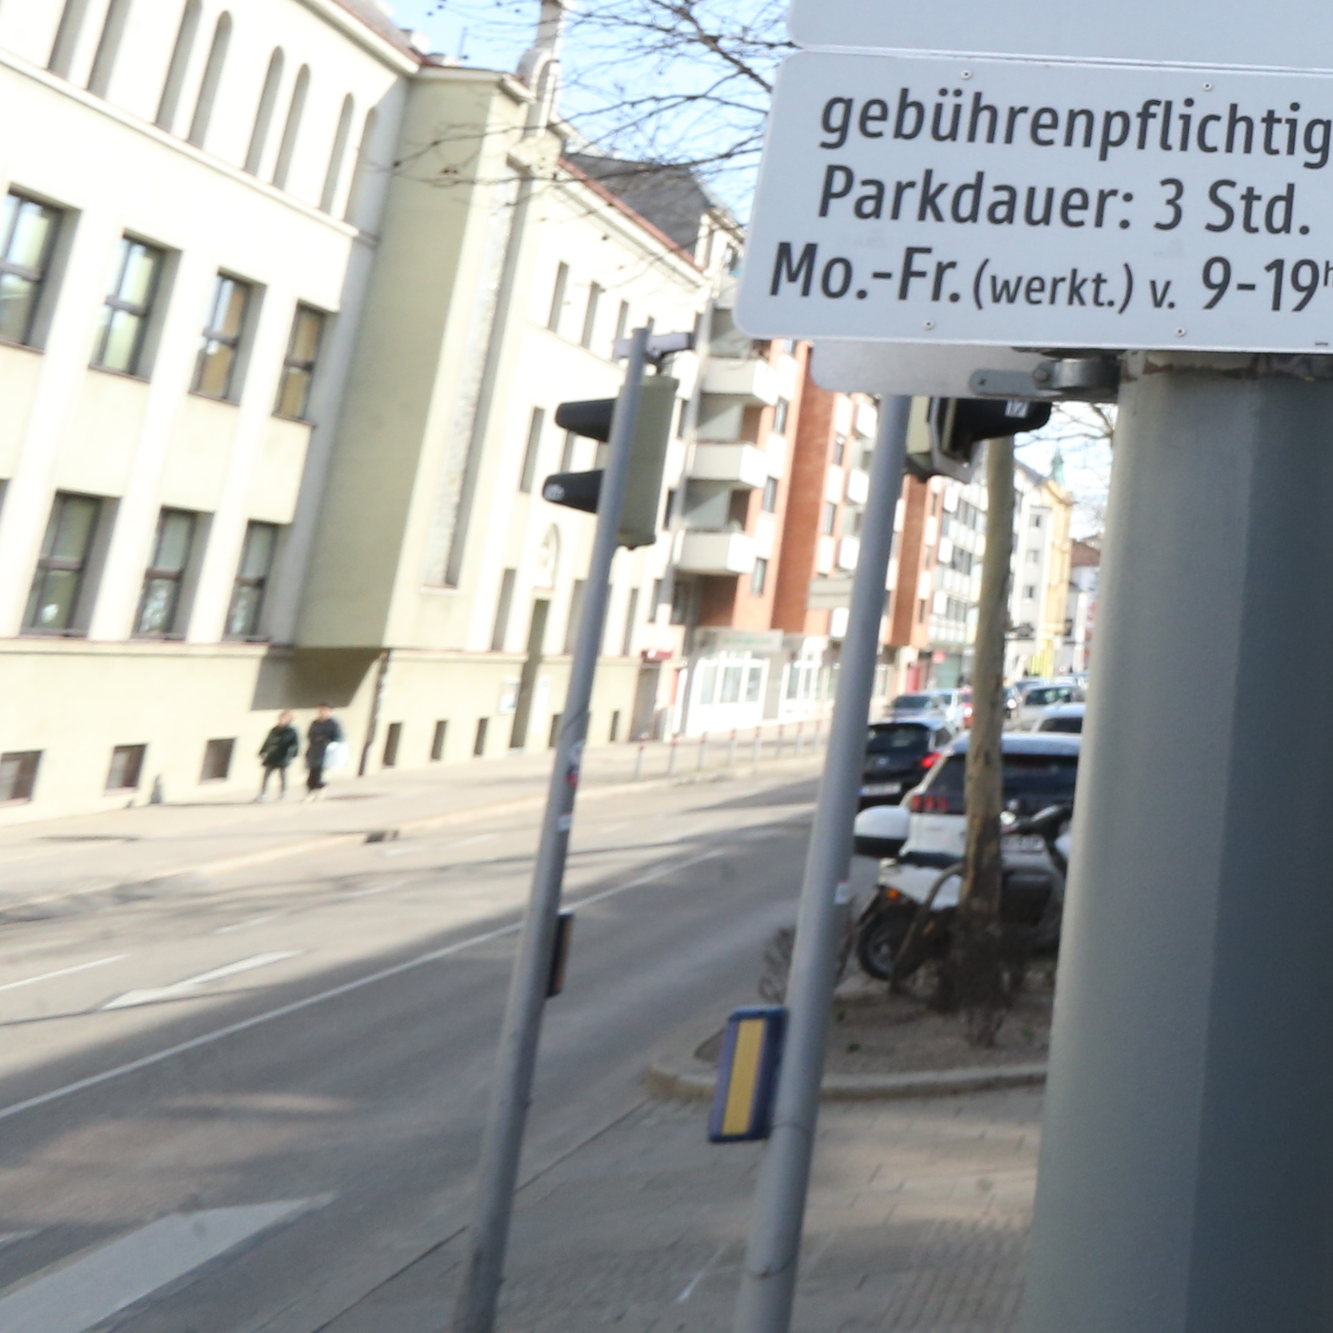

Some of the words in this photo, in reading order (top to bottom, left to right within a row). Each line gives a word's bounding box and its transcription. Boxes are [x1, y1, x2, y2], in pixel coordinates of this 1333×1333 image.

[819, 87, 1333, 169] gebührenpflichtig
[817, 165, 1134, 230] Parkdauer:
[1153, 178, 1184, 231] 3
[1204, 178, 1311, 236] Std.
[769, 241, 961, 303] Mo.-Fr.
[972, 258, 1134, 314] (werkt.)
[1149, 278, 1176, 309] v.
